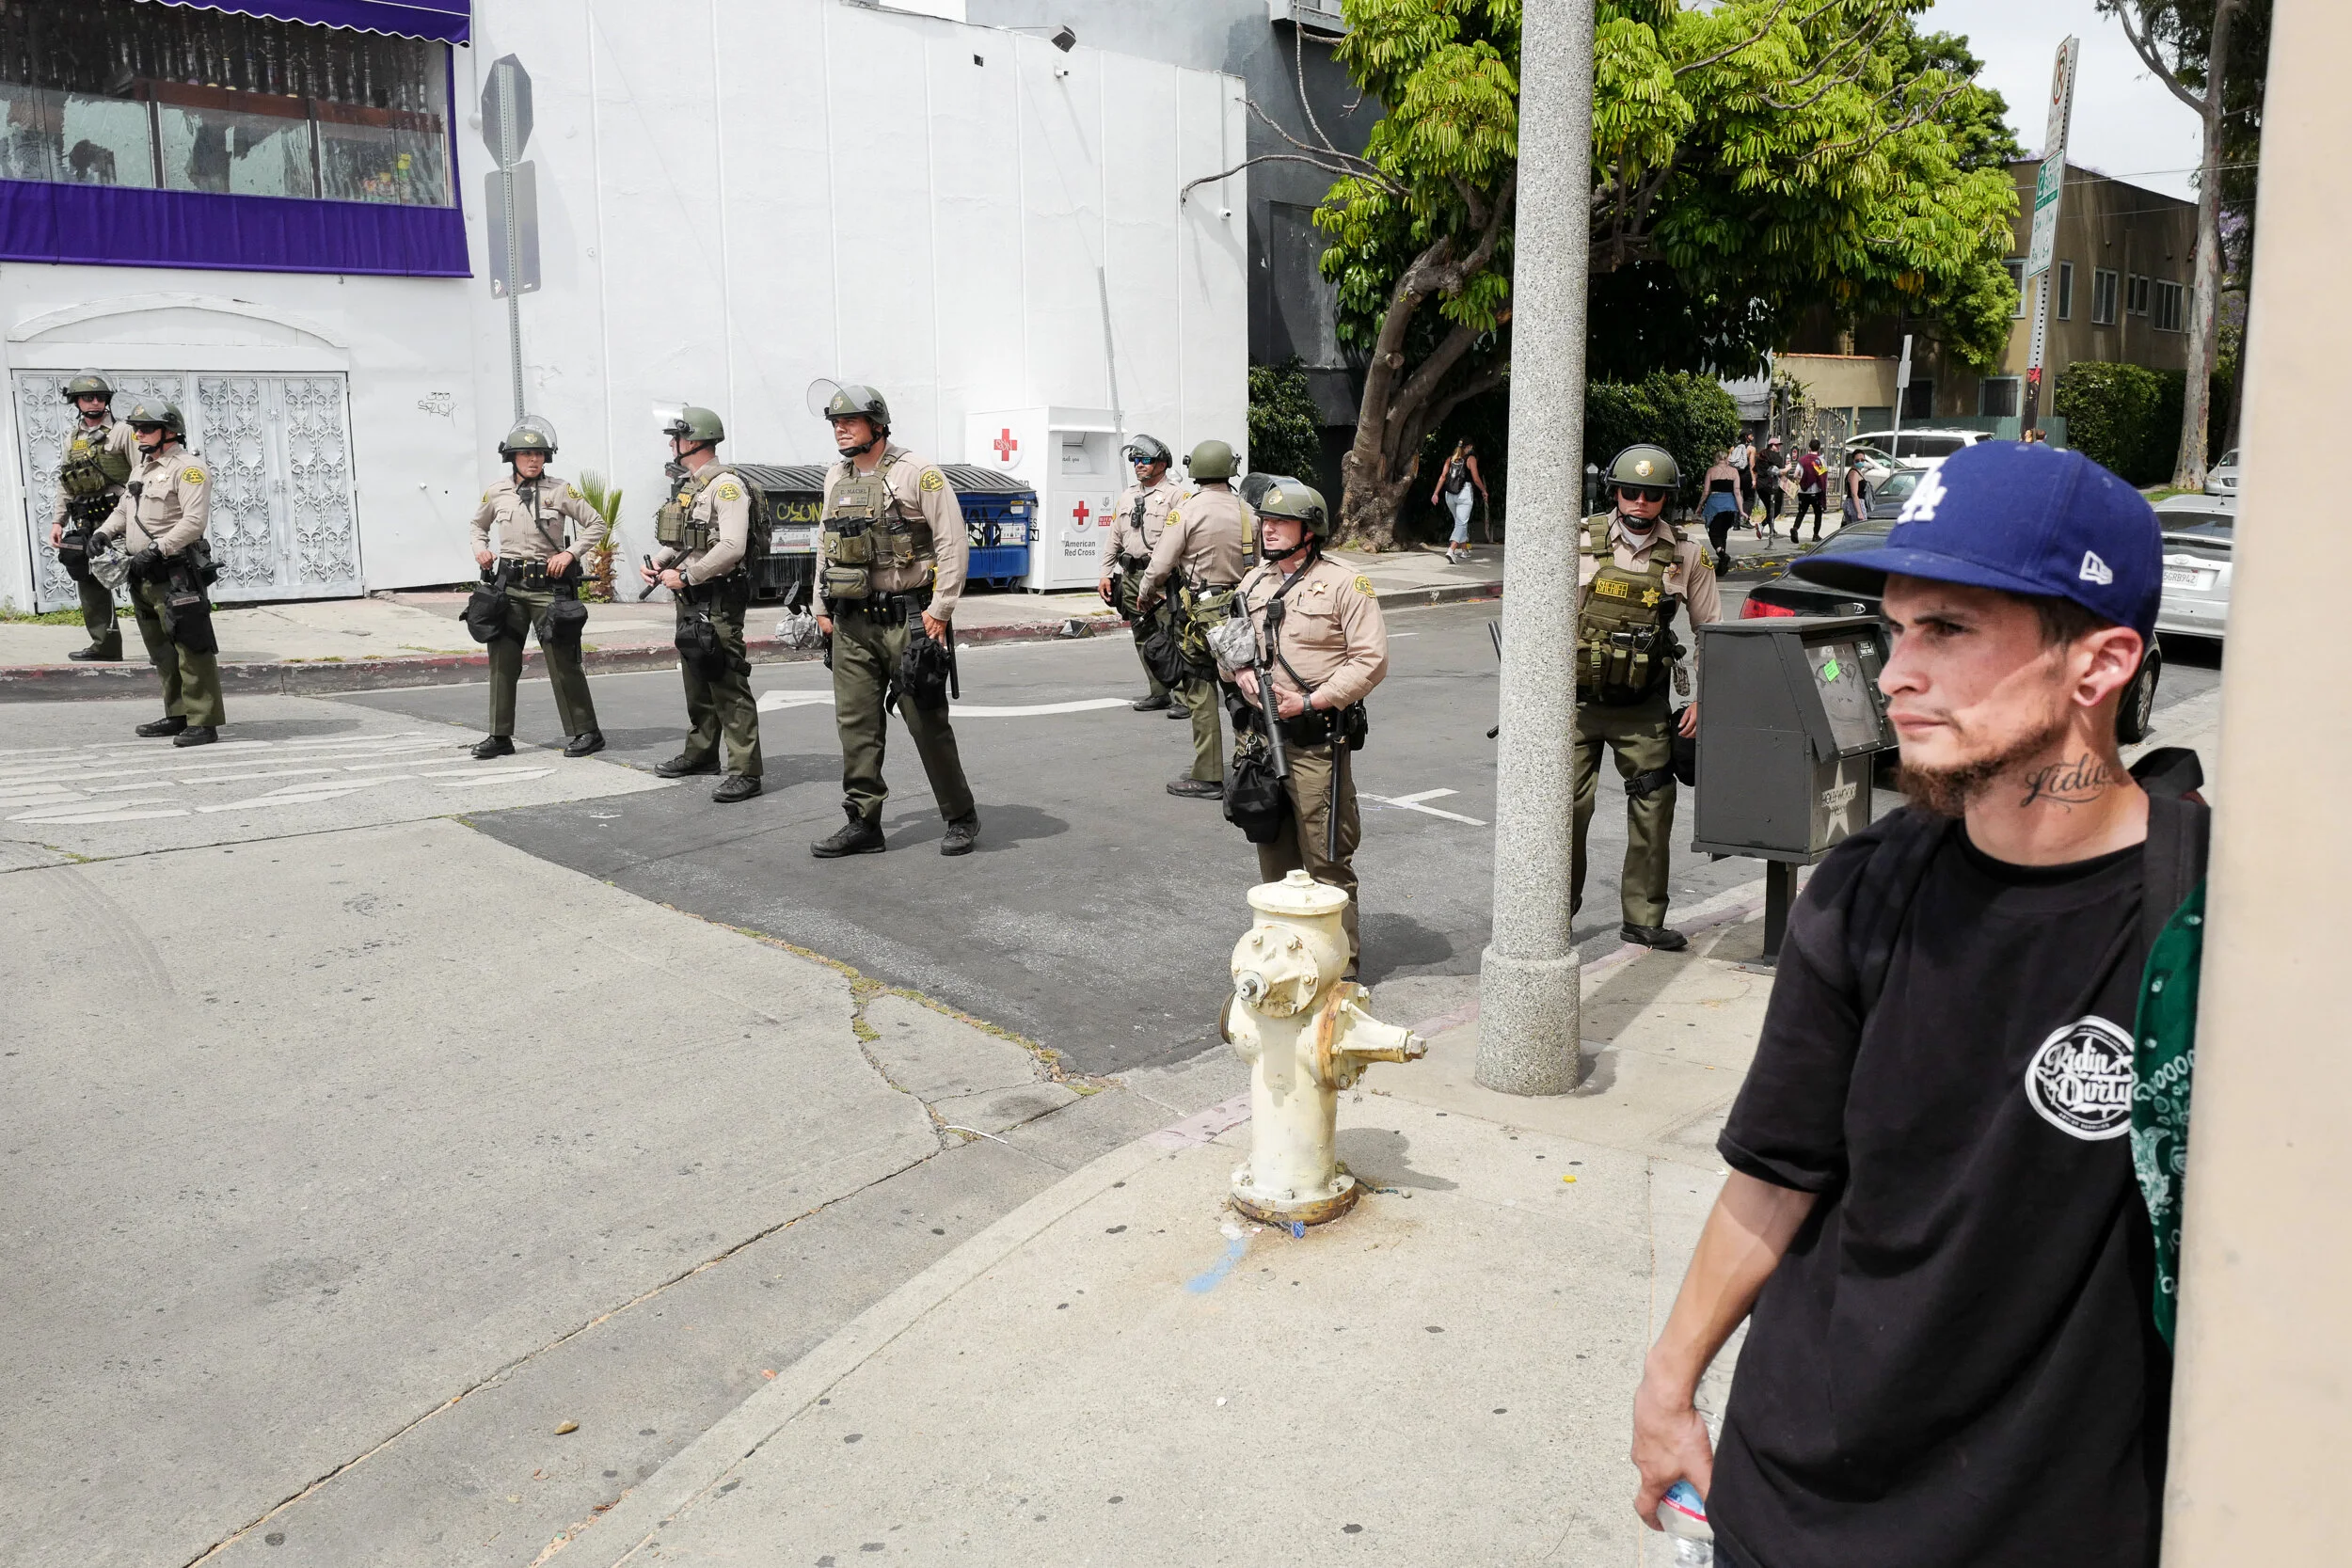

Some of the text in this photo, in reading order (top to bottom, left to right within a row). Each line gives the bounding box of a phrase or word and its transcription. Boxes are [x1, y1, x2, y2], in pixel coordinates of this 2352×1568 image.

[1064, 540, 1096, 548] American
[1064, 548, 1096, 557] Red Cross
[1597, 579, 1627, 597] SHERIFF
[2042, 1036, 2109, 1076] Ridin
[2057, 1074, 2134, 1111] Dirty
